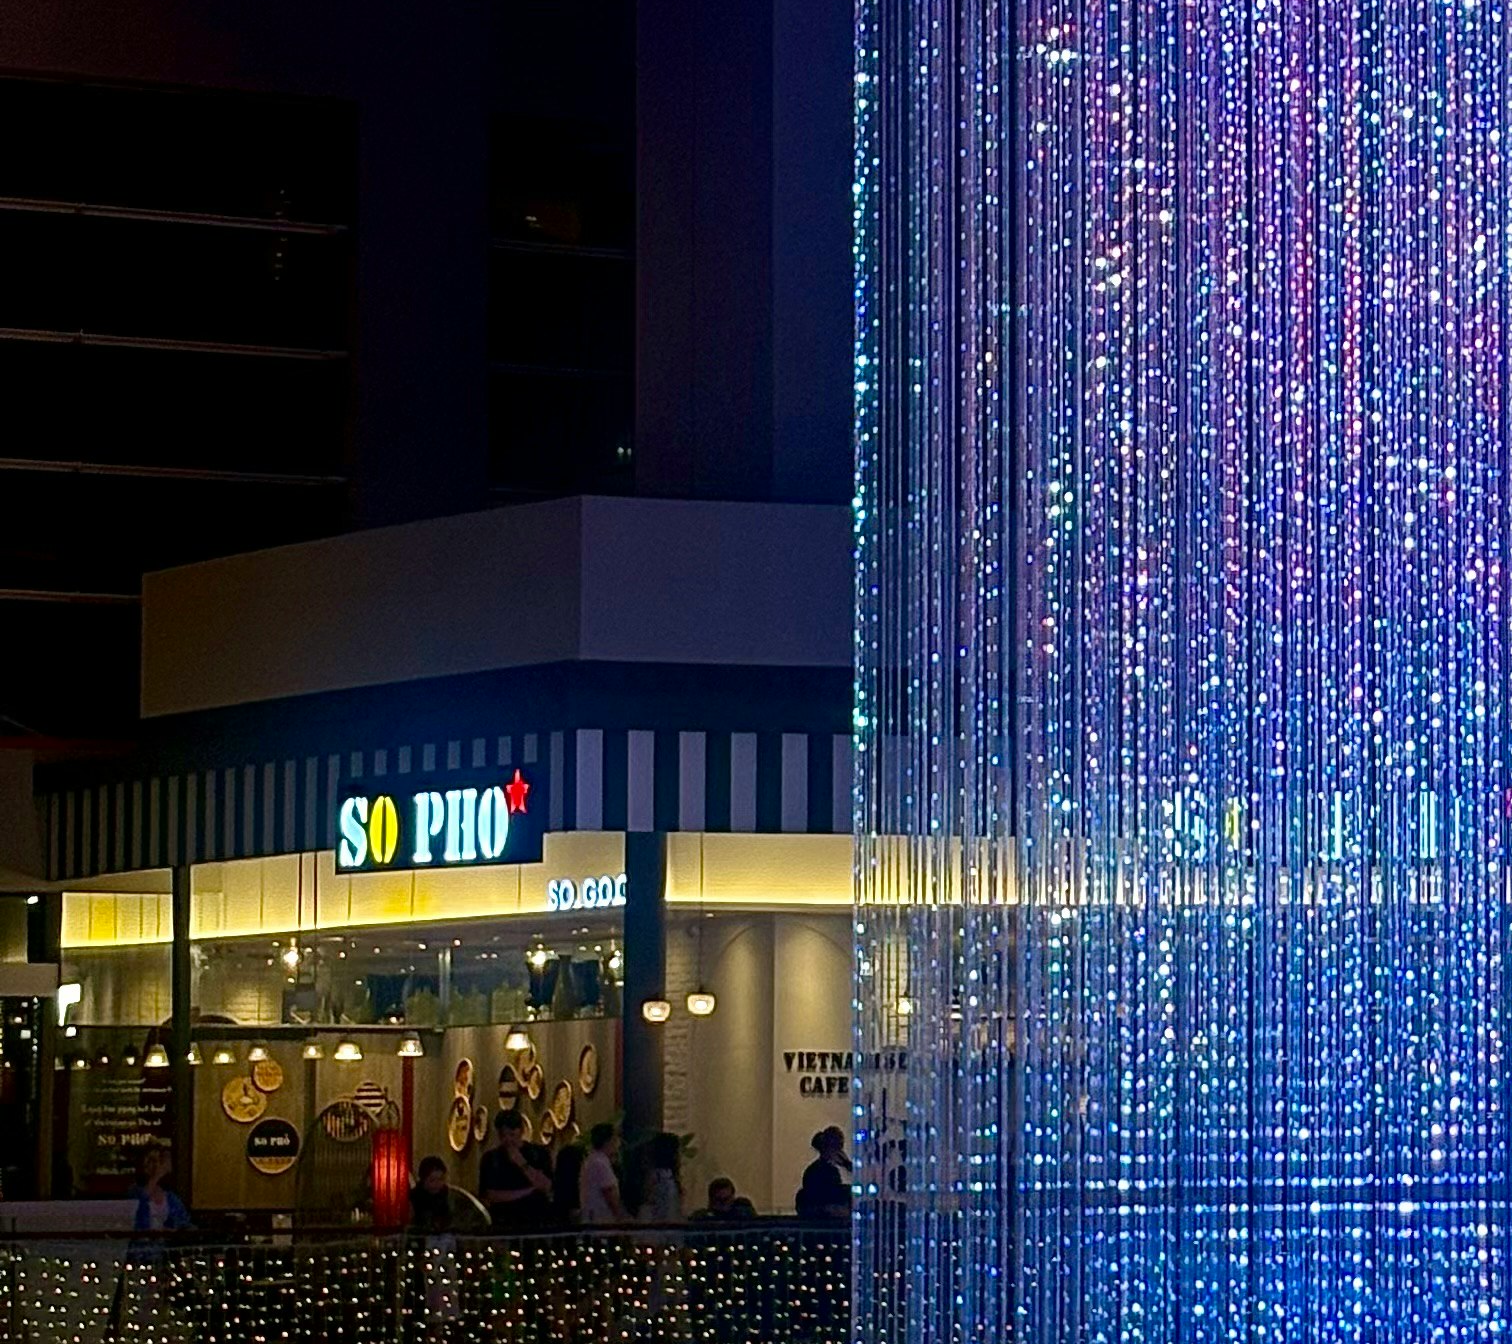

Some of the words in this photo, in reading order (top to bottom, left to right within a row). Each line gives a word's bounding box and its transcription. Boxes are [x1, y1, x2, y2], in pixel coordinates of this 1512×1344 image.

[340, 795, 398, 867] SO
[412, 786, 509, 863] PHO
[548, 878, 576, 911] SO
[800, 1076, 849, 1094] CAFE
